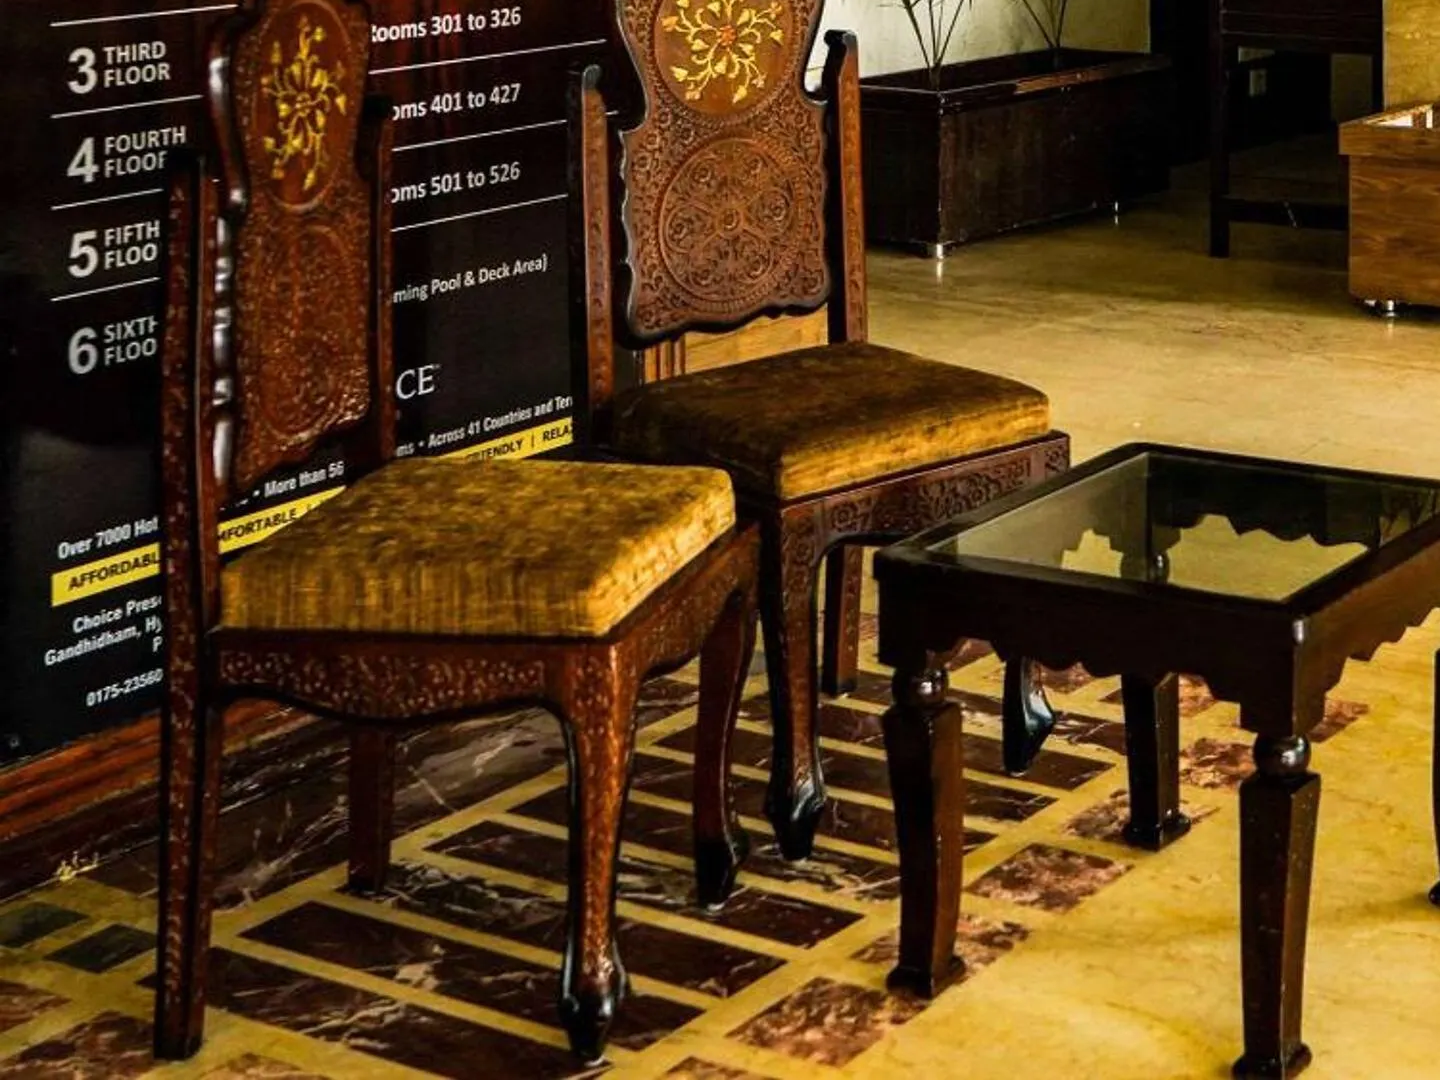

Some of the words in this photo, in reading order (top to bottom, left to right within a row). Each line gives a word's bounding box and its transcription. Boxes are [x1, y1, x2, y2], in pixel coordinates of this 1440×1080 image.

[431, 14, 463, 35] 301
[467, 14, 486, 30] to
[491, 7, 520, 28] 326
[104, 41, 165, 64] THIRD
[69, 48, 97, 93] 3
[105, 63, 170, 87] FLOOR
[430, 93, 462, 113] 401
[467, 92, 485, 108] to
[490, 83, 520, 103] 427
[105, 125, 186, 155] FOURTH
[67, 138, 99, 182] 4
[431, 173, 462, 195] 501
[467, 171, 485, 188] to
[490, 162, 520, 184] 526
[104, 220, 160, 247] FIFTH
[69, 231, 98, 277] 5
[105, 243, 158, 269] FLOO
[432, 273, 461, 294] Pool
[464, 271, 475, 286] &
[479, 263, 510, 283] Deck
[69, 328, 97, 374] 6
[105, 338, 157, 366] FLOO
[58, 537, 92, 560] Over
[96, 524, 131, 548] 7000
[264, 475, 297, 498] More
[300, 467, 327, 488] than
[428, 428, 465, 449] Across
[468, 419, 482, 436] 41
[483, 406, 533, 433] Countries
[534, 402, 553, 418] and
[68, 551, 160, 591] AFFORDABL
[72, 608, 123, 634] Choice
[44, 623, 143, 666] Gandhidham,
[86, 668, 164, 706] 0175-23560
